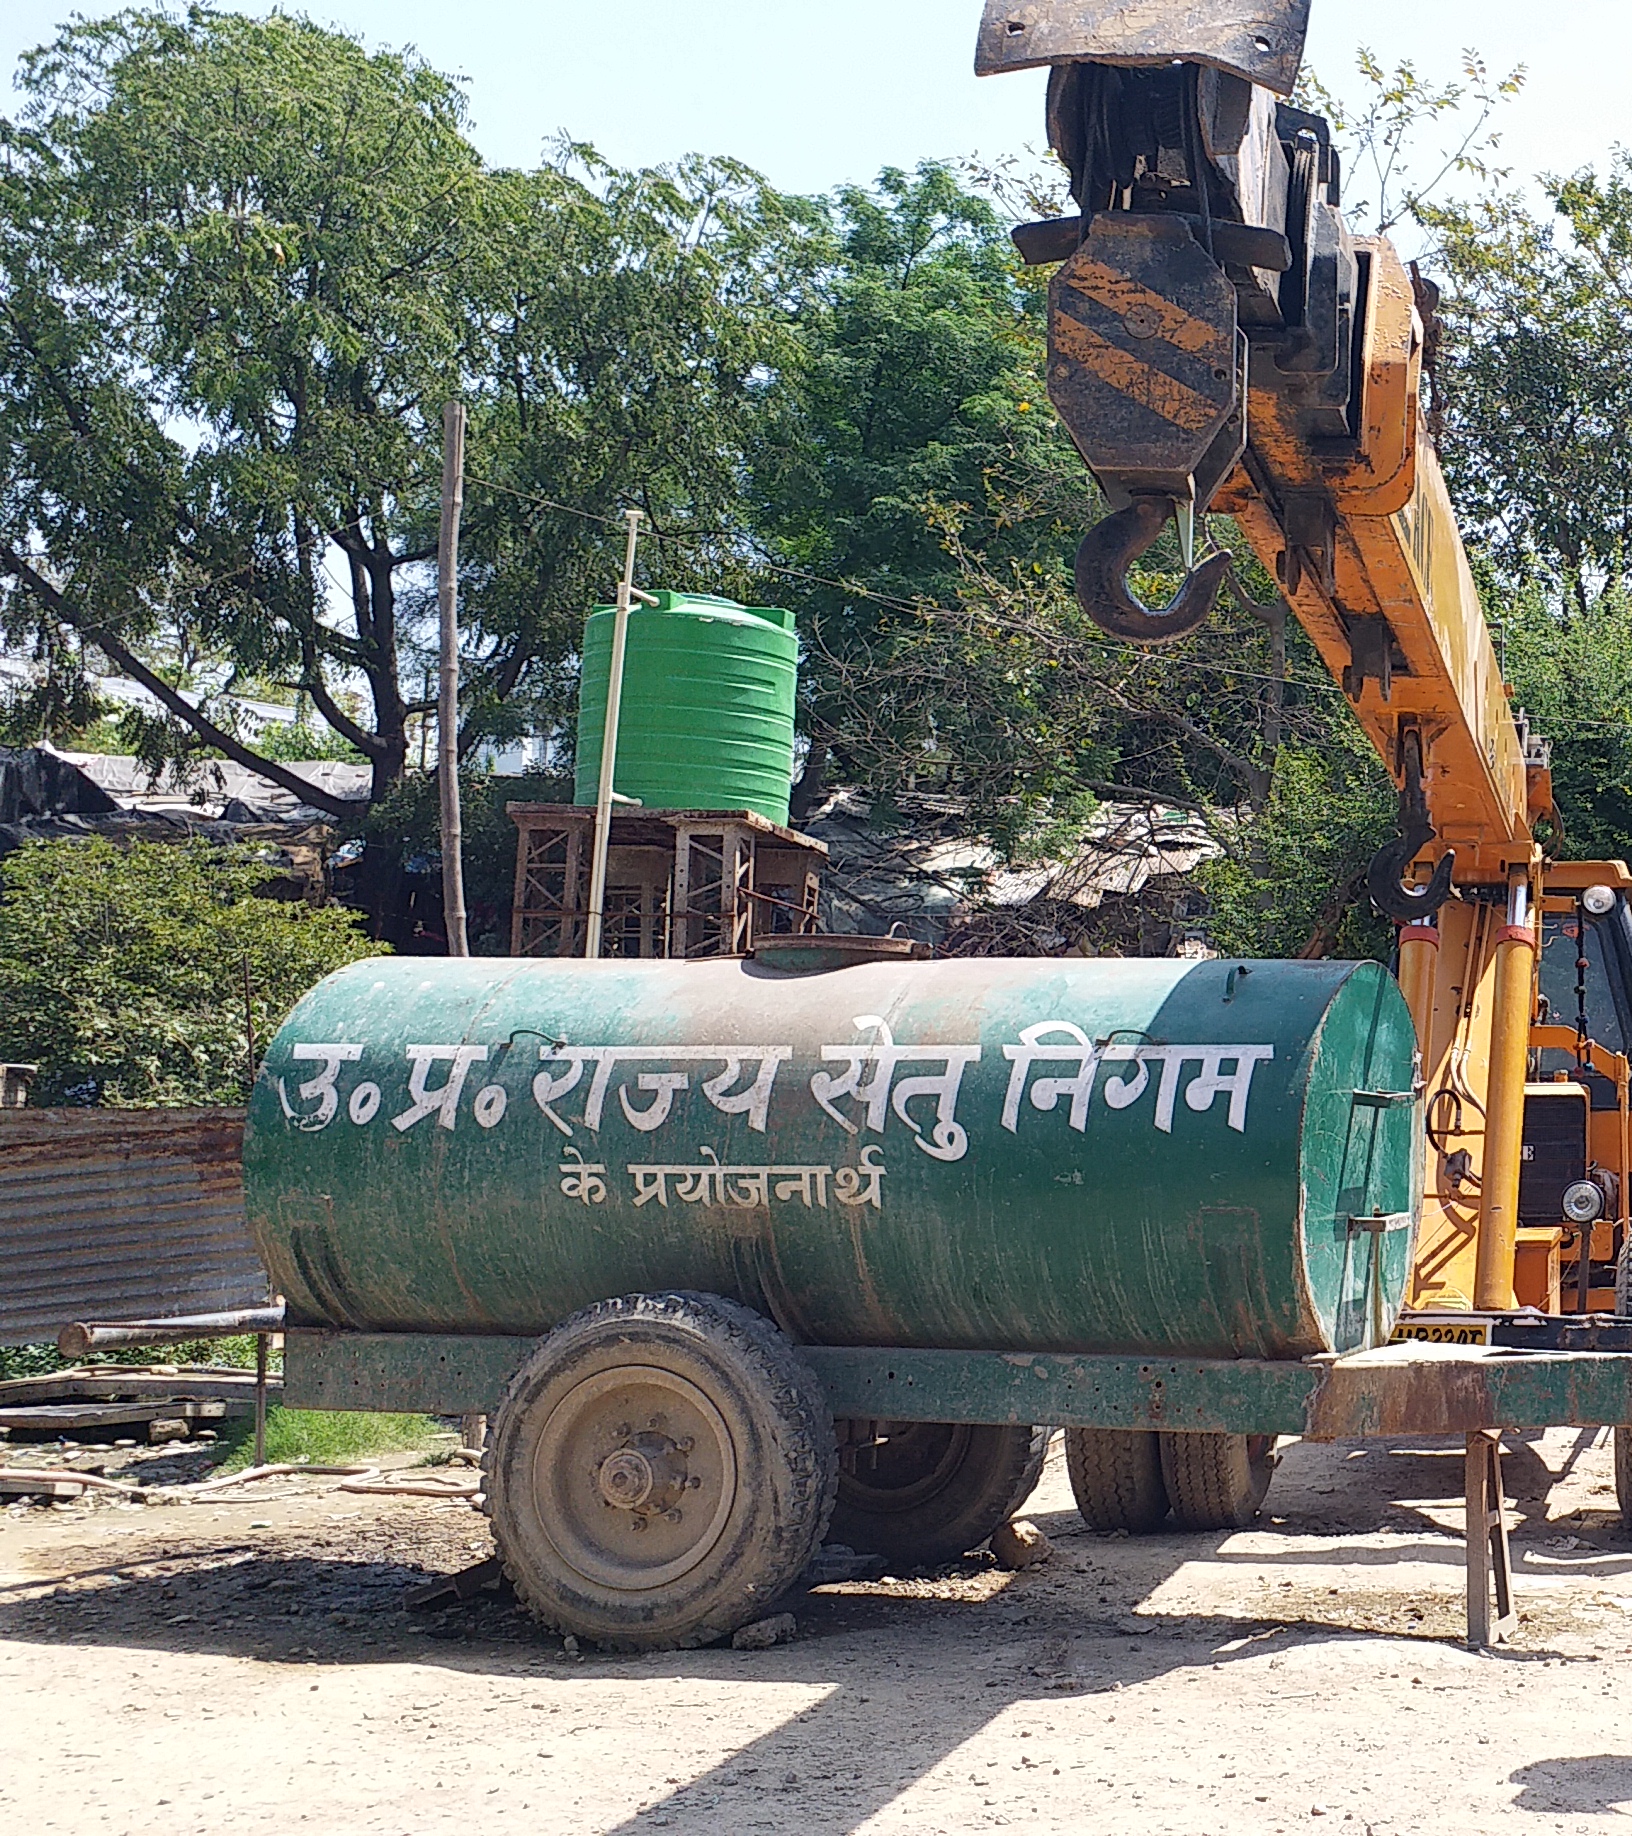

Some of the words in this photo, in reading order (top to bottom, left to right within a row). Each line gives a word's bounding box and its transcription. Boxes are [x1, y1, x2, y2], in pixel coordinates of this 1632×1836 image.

[533, 1045, 794, 1137] राज्य
[811, 1015, 982, 1161] सेतु
[1001, 1020, 1274, 1133] निगम
[558, 1145, 607, 1206] के
[627, 1145, 888, 1209] प्रयोजनार्थ
